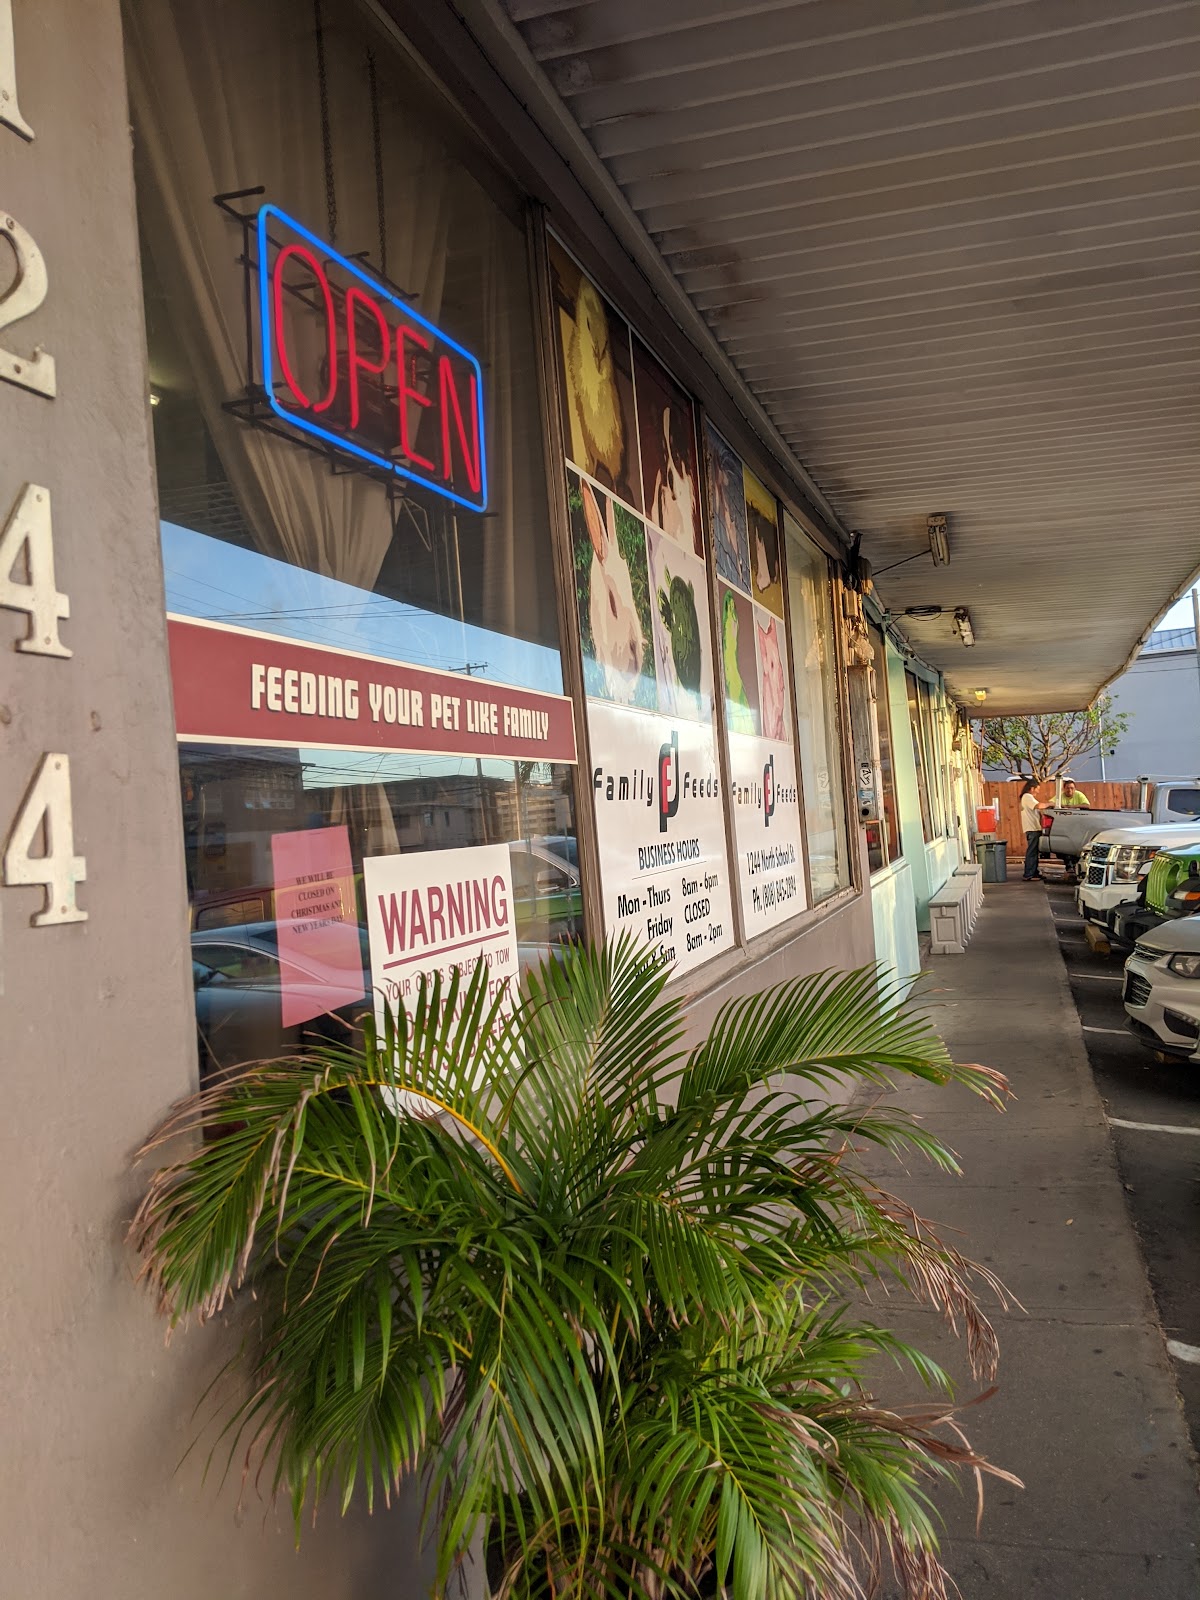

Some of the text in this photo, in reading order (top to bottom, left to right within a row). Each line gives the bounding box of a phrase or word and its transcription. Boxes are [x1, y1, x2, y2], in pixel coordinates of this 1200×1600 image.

[273, 244, 480, 493] OPEN
[251, 663, 549, 740] FEEDING YOUR PET LIKE FAMILY
[638, 838, 700, 870] BUSINESS HOURS
[747, 851, 761, 875] 1244
[761, 846, 775, 871] North
[298, 886, 335, 901] CLOSED ON
[308, 872, 325, 883] WILL
[291, 903, 329, 919] CHRISTMAS
[617, 894, 640, 918] Mon
[647, 885, 671, 908] Thurs
[681, 878, 698, 897] 8am
[704, 872, 718, 892] 6pm
[292, 923, 308, 934] NEW
[378, 875, 509, 955] WARNING
[647, 898, 710, 940] Friday CLOSED
[686, 933, 702, 952] 8am
[708, 923, 723, 944] 2pm
[386, 978, 411, 1002] YOUR
[416, 972, 433, 992] CR
[495, 948, 510, 966] TOW
